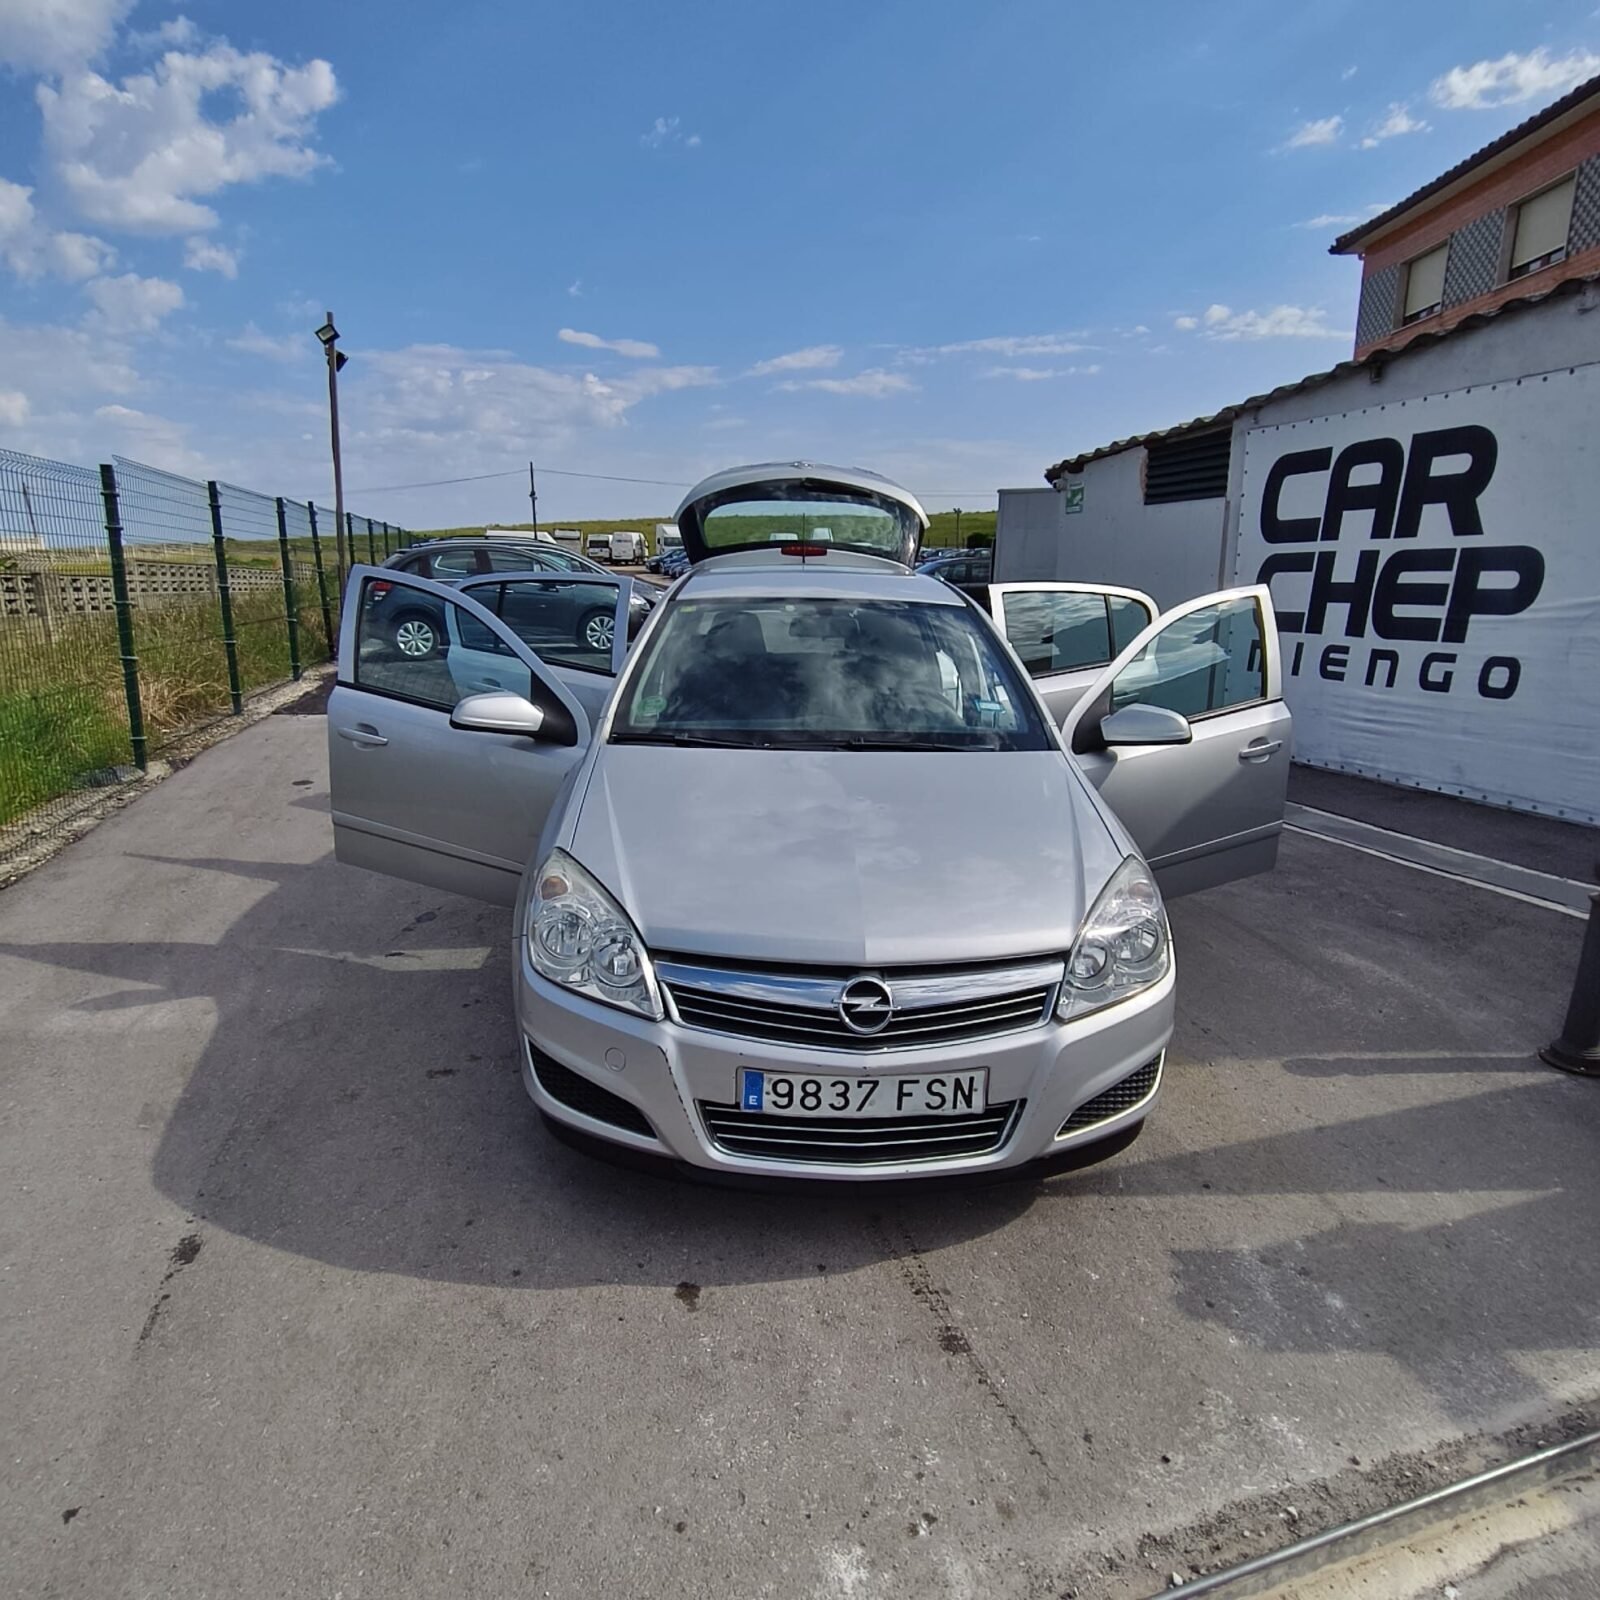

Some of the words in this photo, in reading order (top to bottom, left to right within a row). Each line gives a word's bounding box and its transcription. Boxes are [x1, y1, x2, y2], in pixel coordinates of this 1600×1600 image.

[1260, 424, 1498, 544] CAR
[1253, 545, 1545, 644] CHEP
[749, 1095, 758, 1105] E
[771, 1078, 880, 1112] 9837
[896, 1076, 975, 1111] FSN
